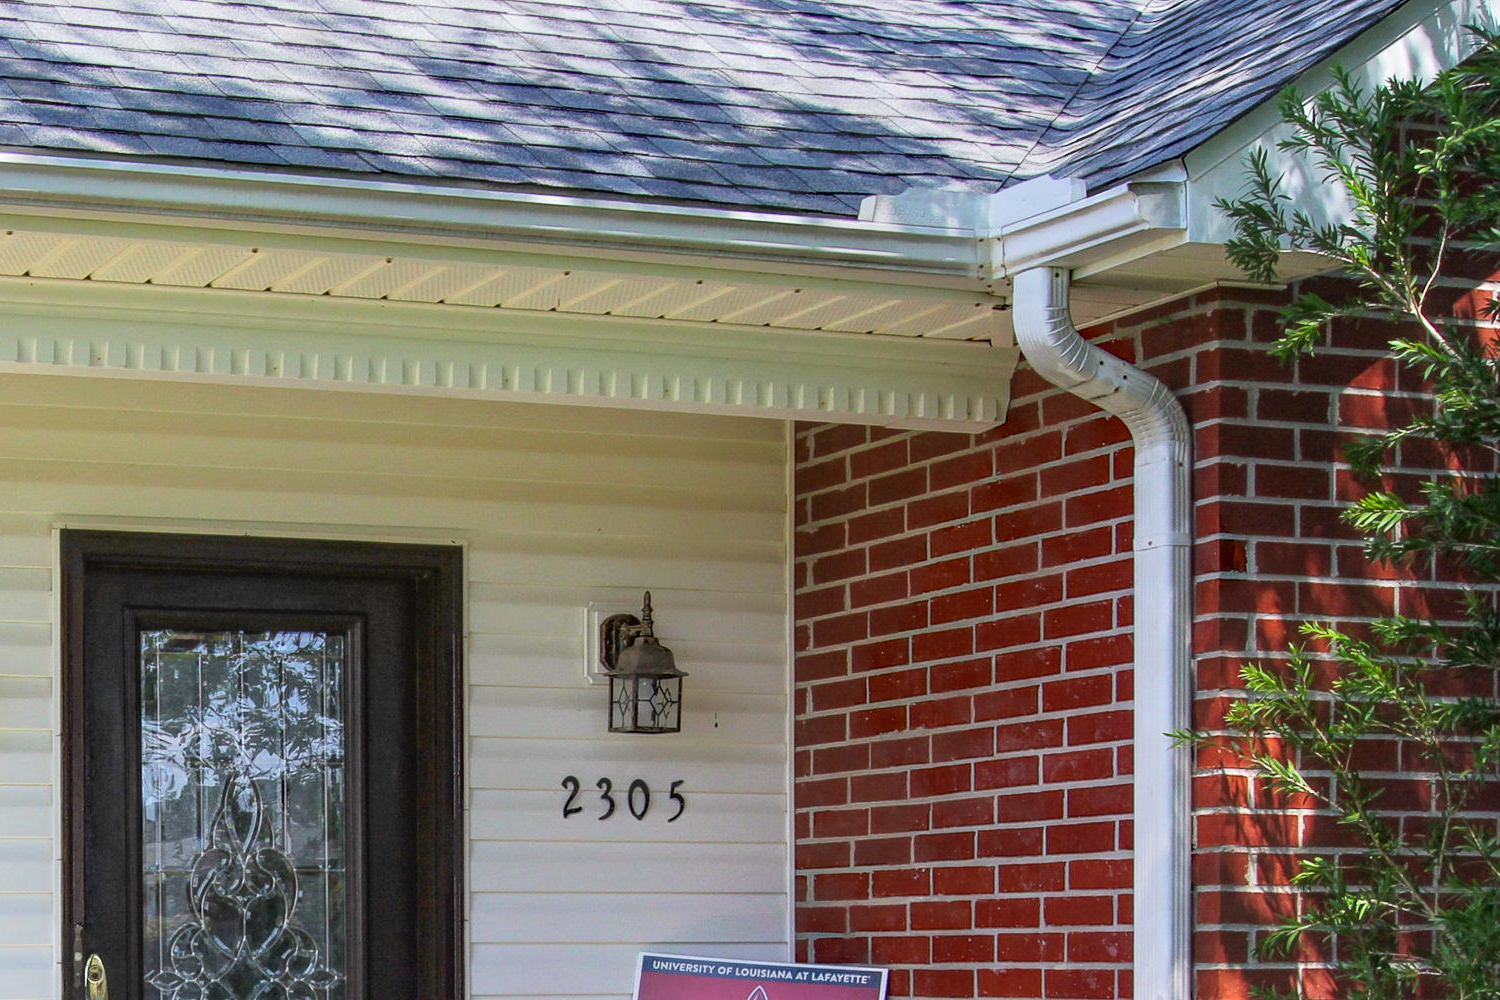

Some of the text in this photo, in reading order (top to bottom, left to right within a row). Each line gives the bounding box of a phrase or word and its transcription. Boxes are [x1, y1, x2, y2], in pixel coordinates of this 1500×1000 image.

[561, 775, 685, 823] 2305
[652, 960, 716, 975] UNIVERSITY
[717, 966, 733, 976] OF
[735, 967, 793, 981] LOUISIANA
[795, 971, 809, 981] AT
